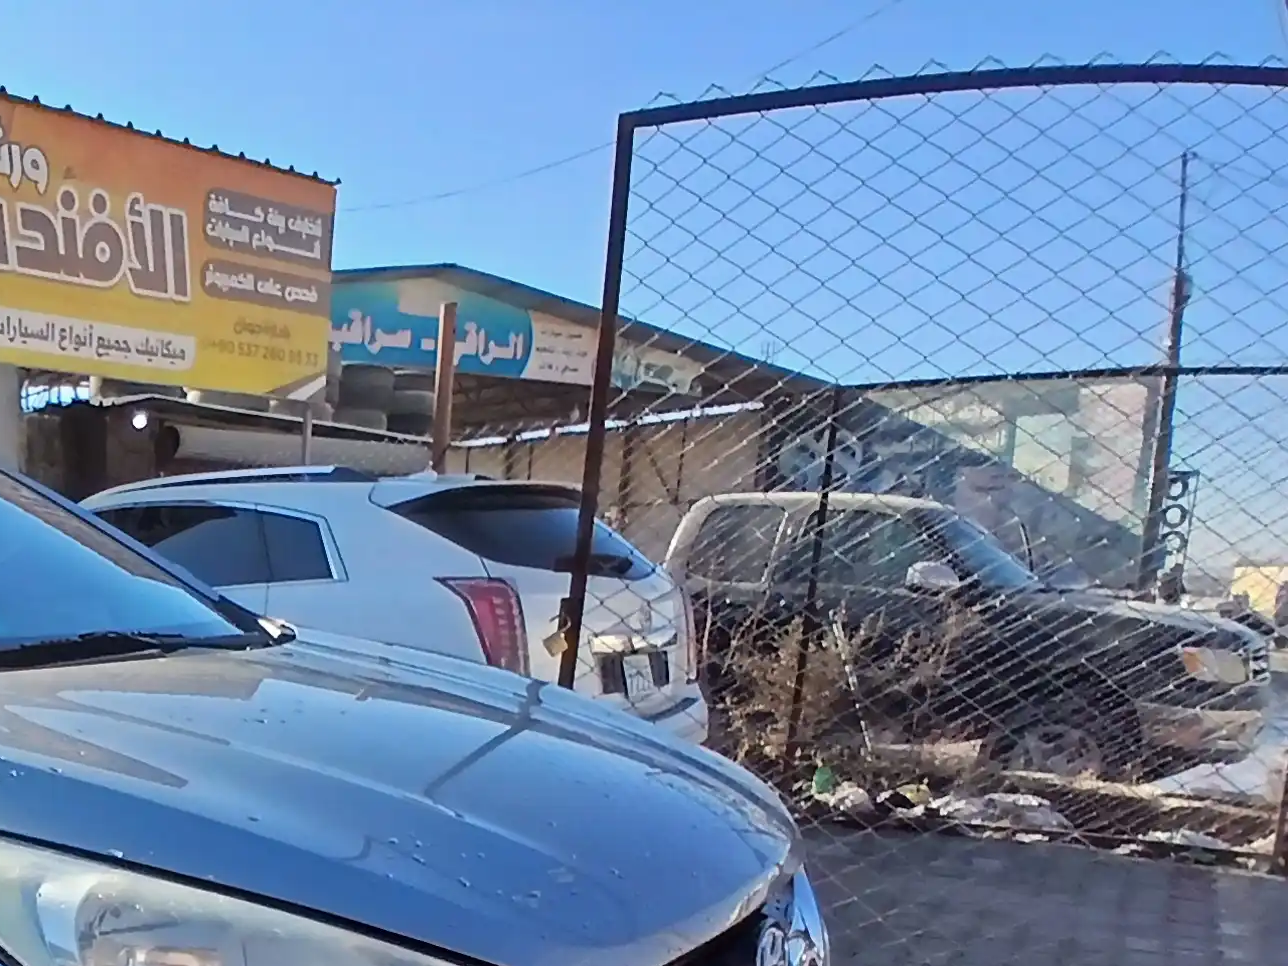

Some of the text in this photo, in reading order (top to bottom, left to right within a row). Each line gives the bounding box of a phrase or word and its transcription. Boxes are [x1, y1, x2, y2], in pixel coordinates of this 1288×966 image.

[58, 325, 94, 351] أنواع
[96, 333, 132, 359] جميع
[135, 335, 186, 365] ميكانيك
